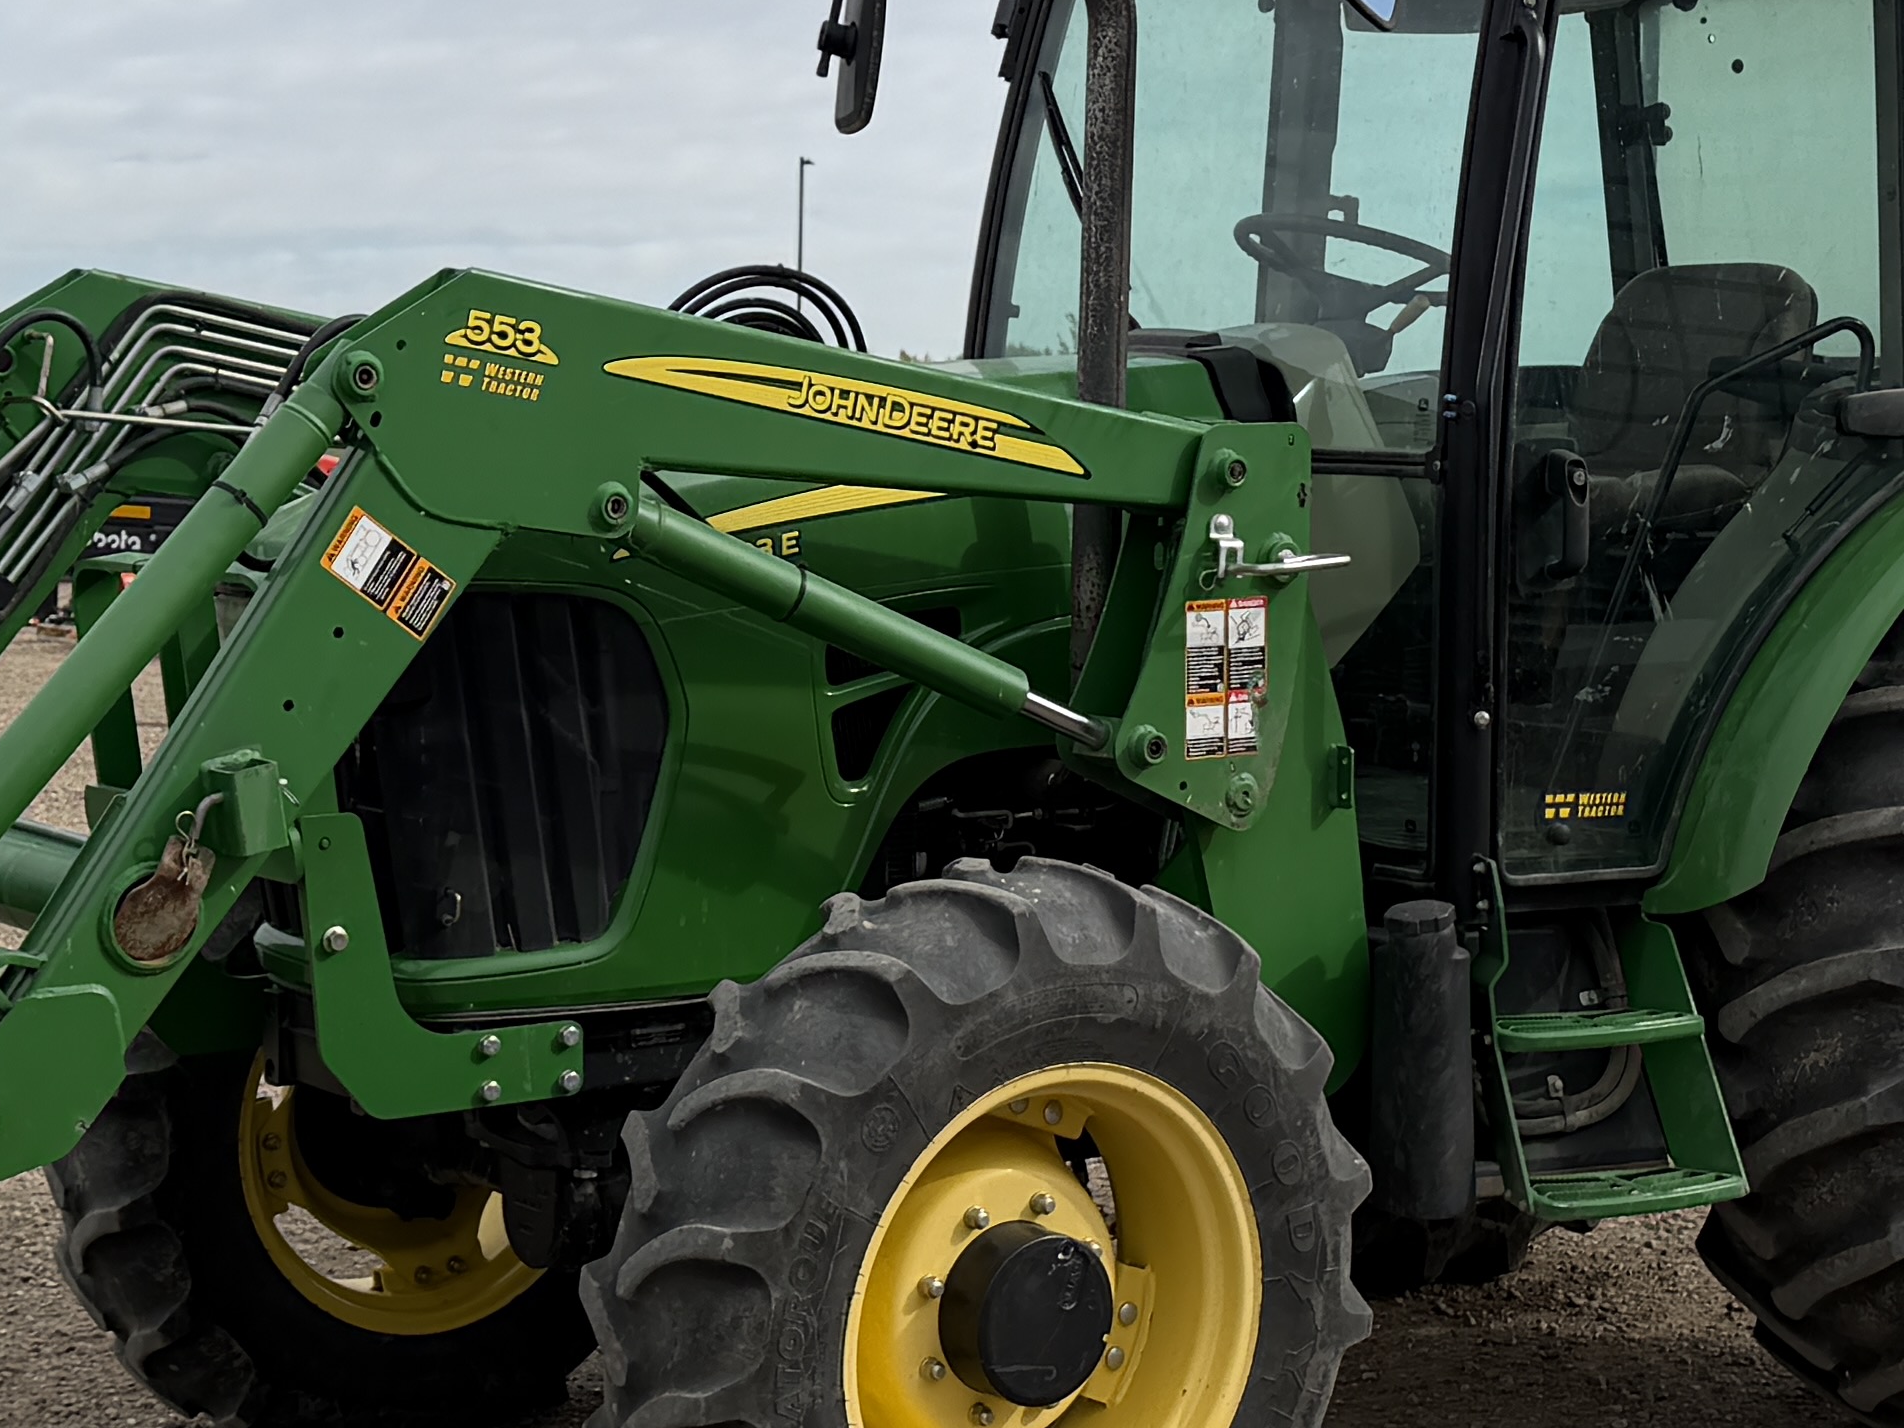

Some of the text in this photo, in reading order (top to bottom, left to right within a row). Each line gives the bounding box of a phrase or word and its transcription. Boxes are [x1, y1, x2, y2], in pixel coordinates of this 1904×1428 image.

[466, 308, 542, 356] 553
[484, 362, 545, 386] WESTERN
[481, 377, 540, 401] TRACTOR
[787, 374, 998, 451] JOHN DEERE
[1577, 805, 1625, 818] TRACTOR
